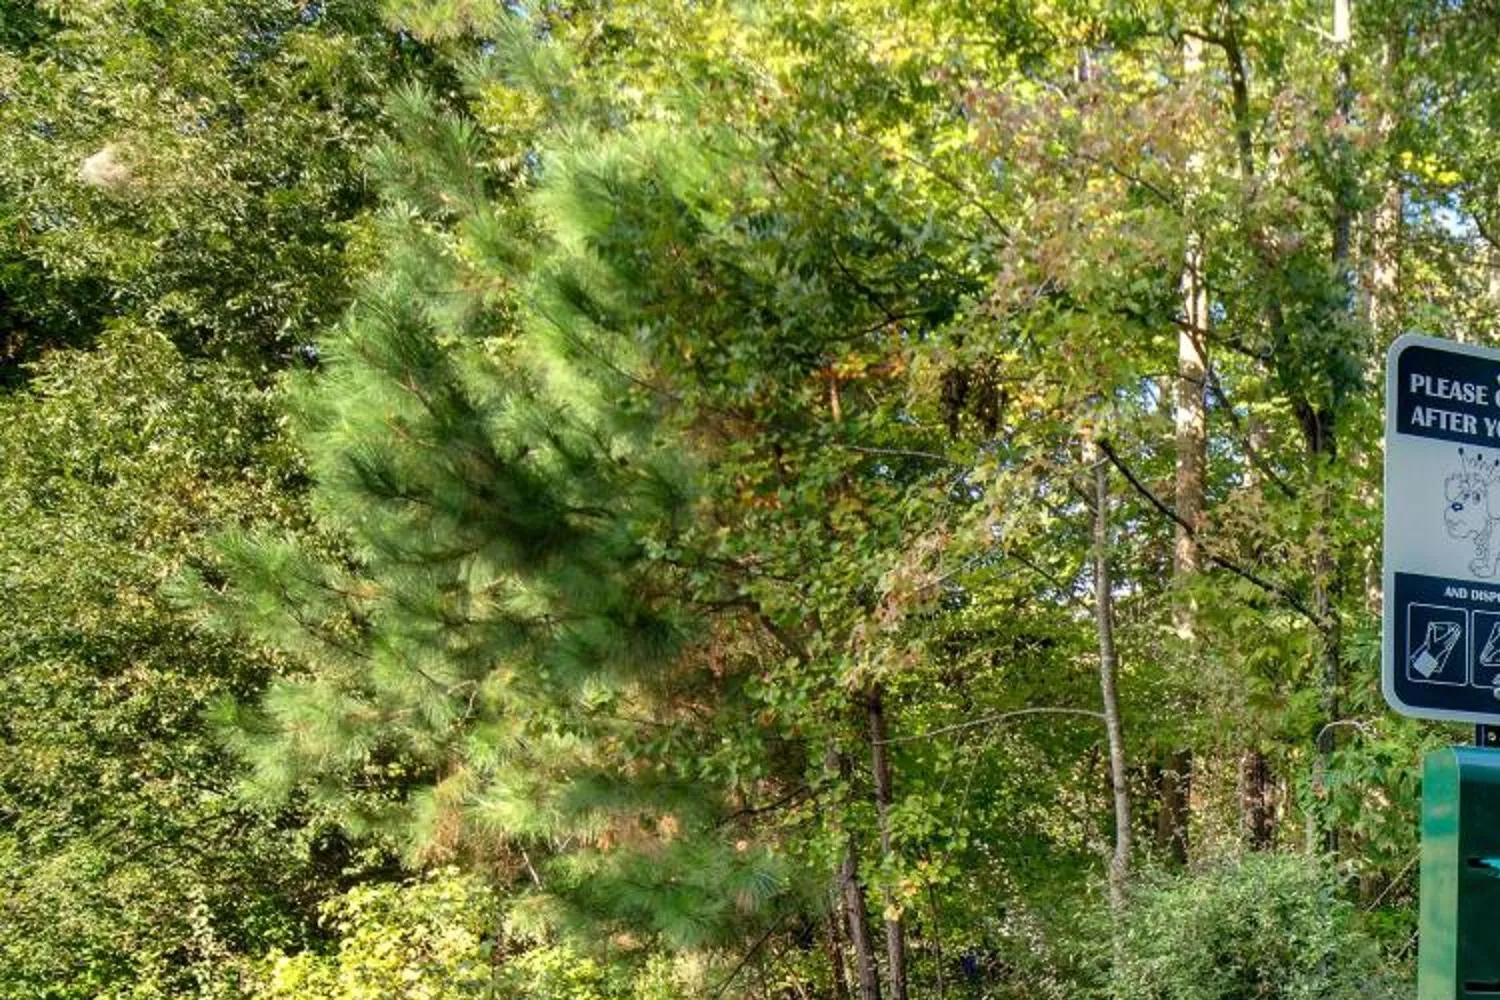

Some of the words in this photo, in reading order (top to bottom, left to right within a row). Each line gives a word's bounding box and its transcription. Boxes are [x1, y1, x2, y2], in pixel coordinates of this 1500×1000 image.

[1410, 373, 1489, 405] PLEASE
[1411, 405, 1478, 435] AFTER
[1444, 586, 1469, 600] AND
